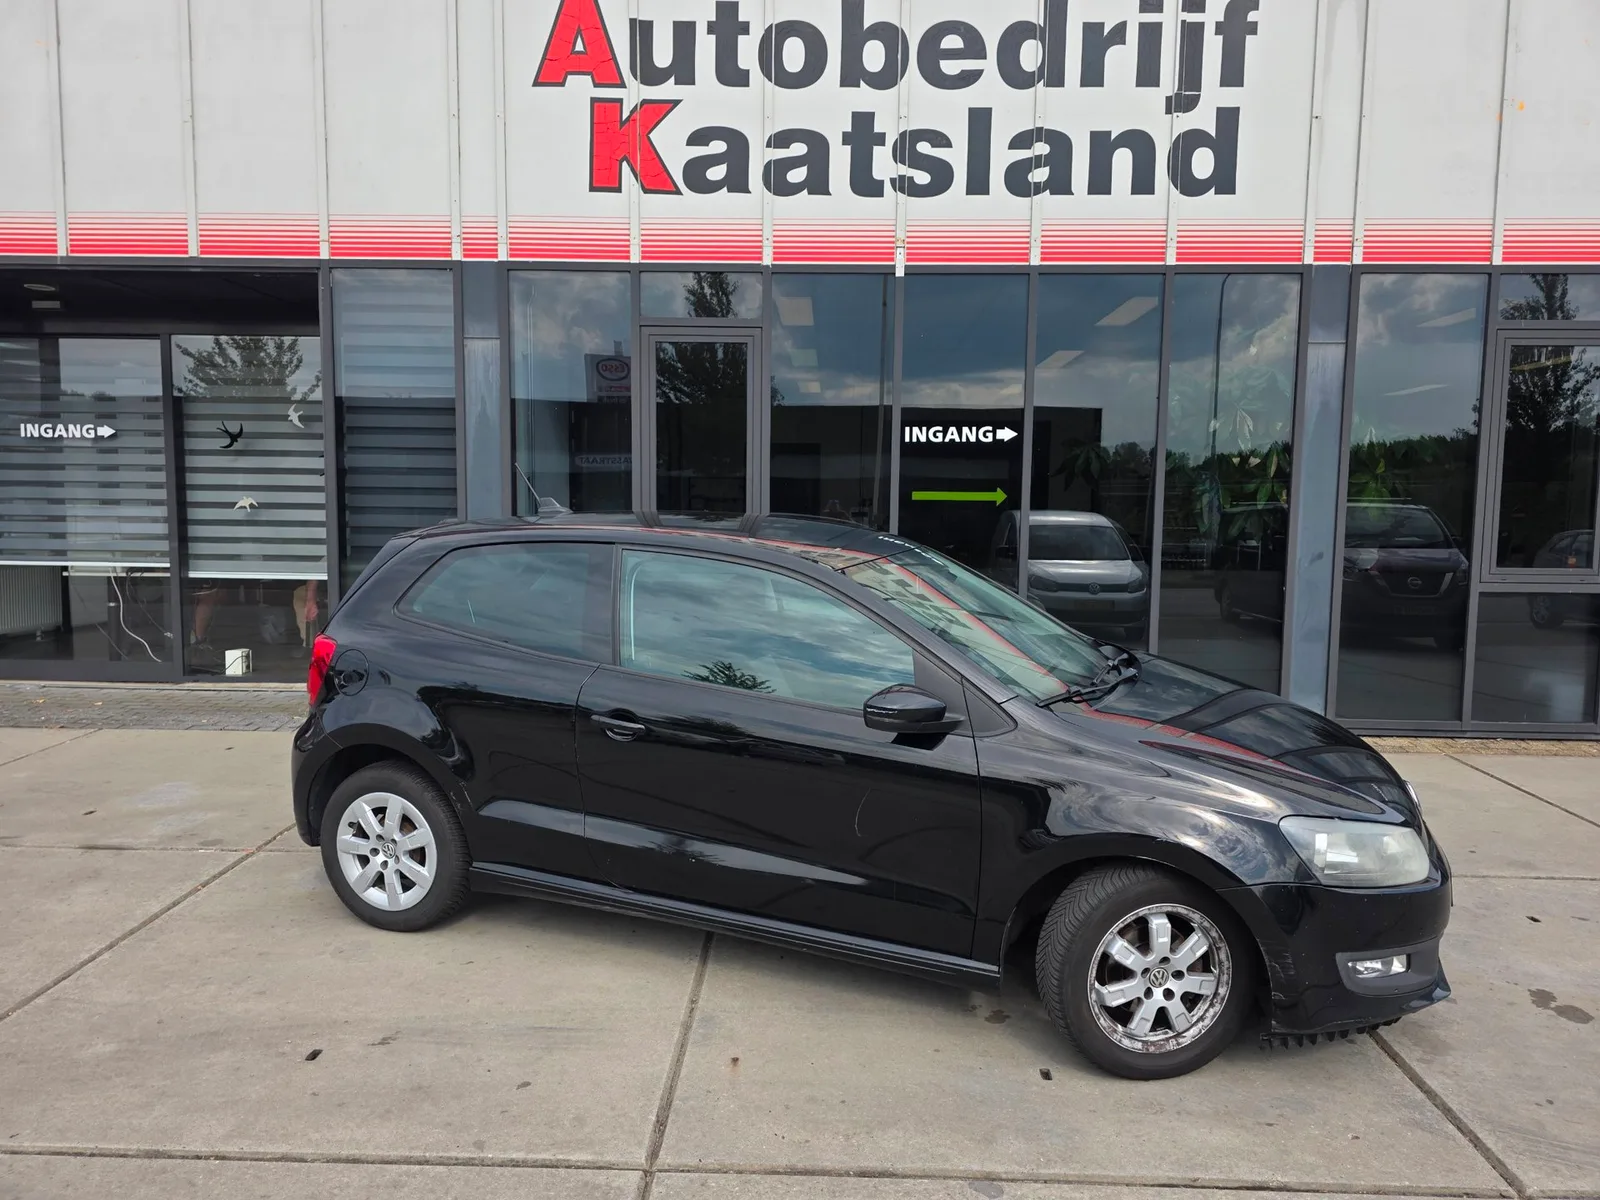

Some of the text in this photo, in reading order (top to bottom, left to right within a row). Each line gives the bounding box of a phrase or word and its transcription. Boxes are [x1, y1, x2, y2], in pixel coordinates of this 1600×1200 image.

[532, 0, 1260, 115] Autobedrijf
[589, 97, 1240, 197] Kaatsland
[20, 423, 95, 438] INGANG
[904, 426, 993, 443] INGANG
